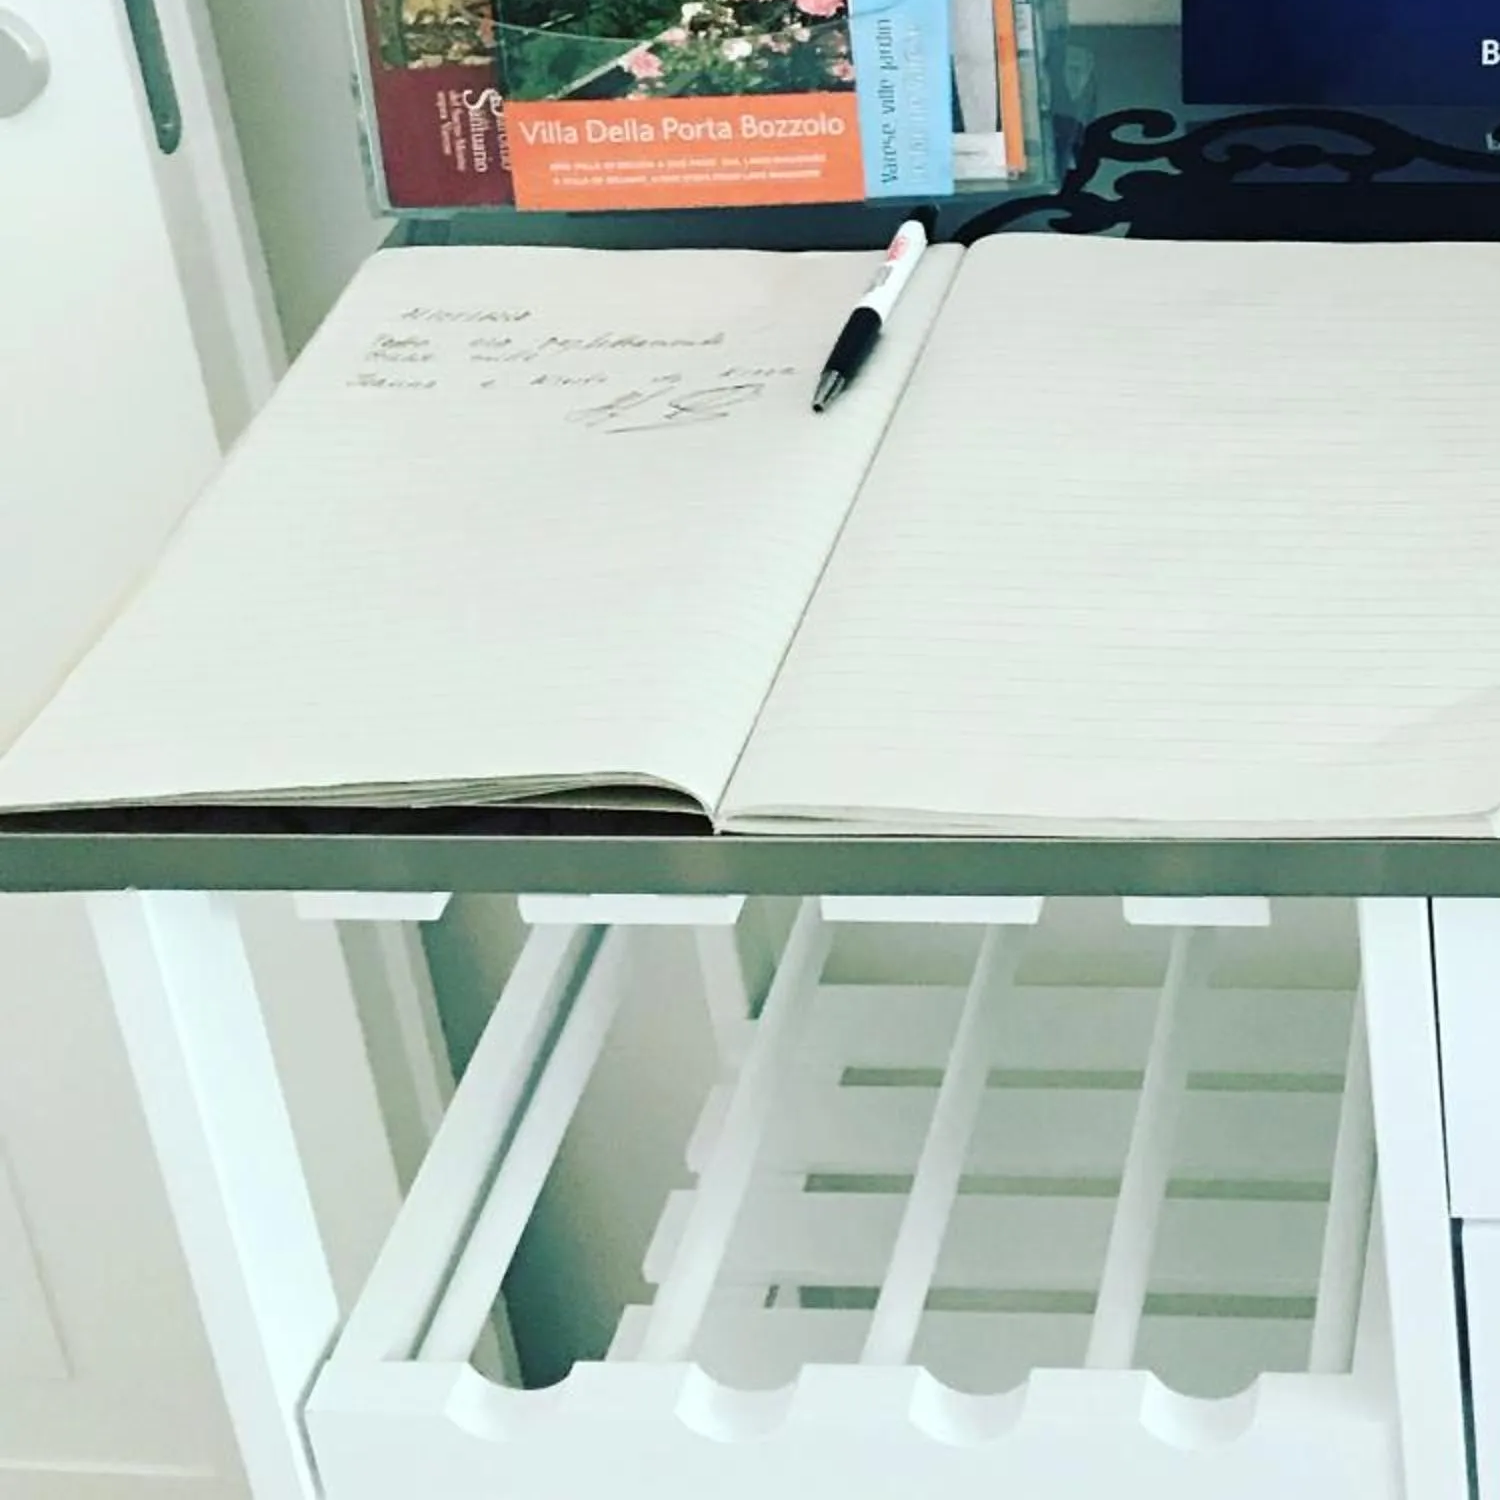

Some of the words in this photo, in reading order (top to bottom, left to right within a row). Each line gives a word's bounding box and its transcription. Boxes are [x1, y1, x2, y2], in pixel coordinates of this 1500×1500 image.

[518, 119, 579, 145] Villa
[585, 118, 655, 144] Della
[661, 116, 733, 142] Porta
[740, 111, 846, 139] Bozzolo
